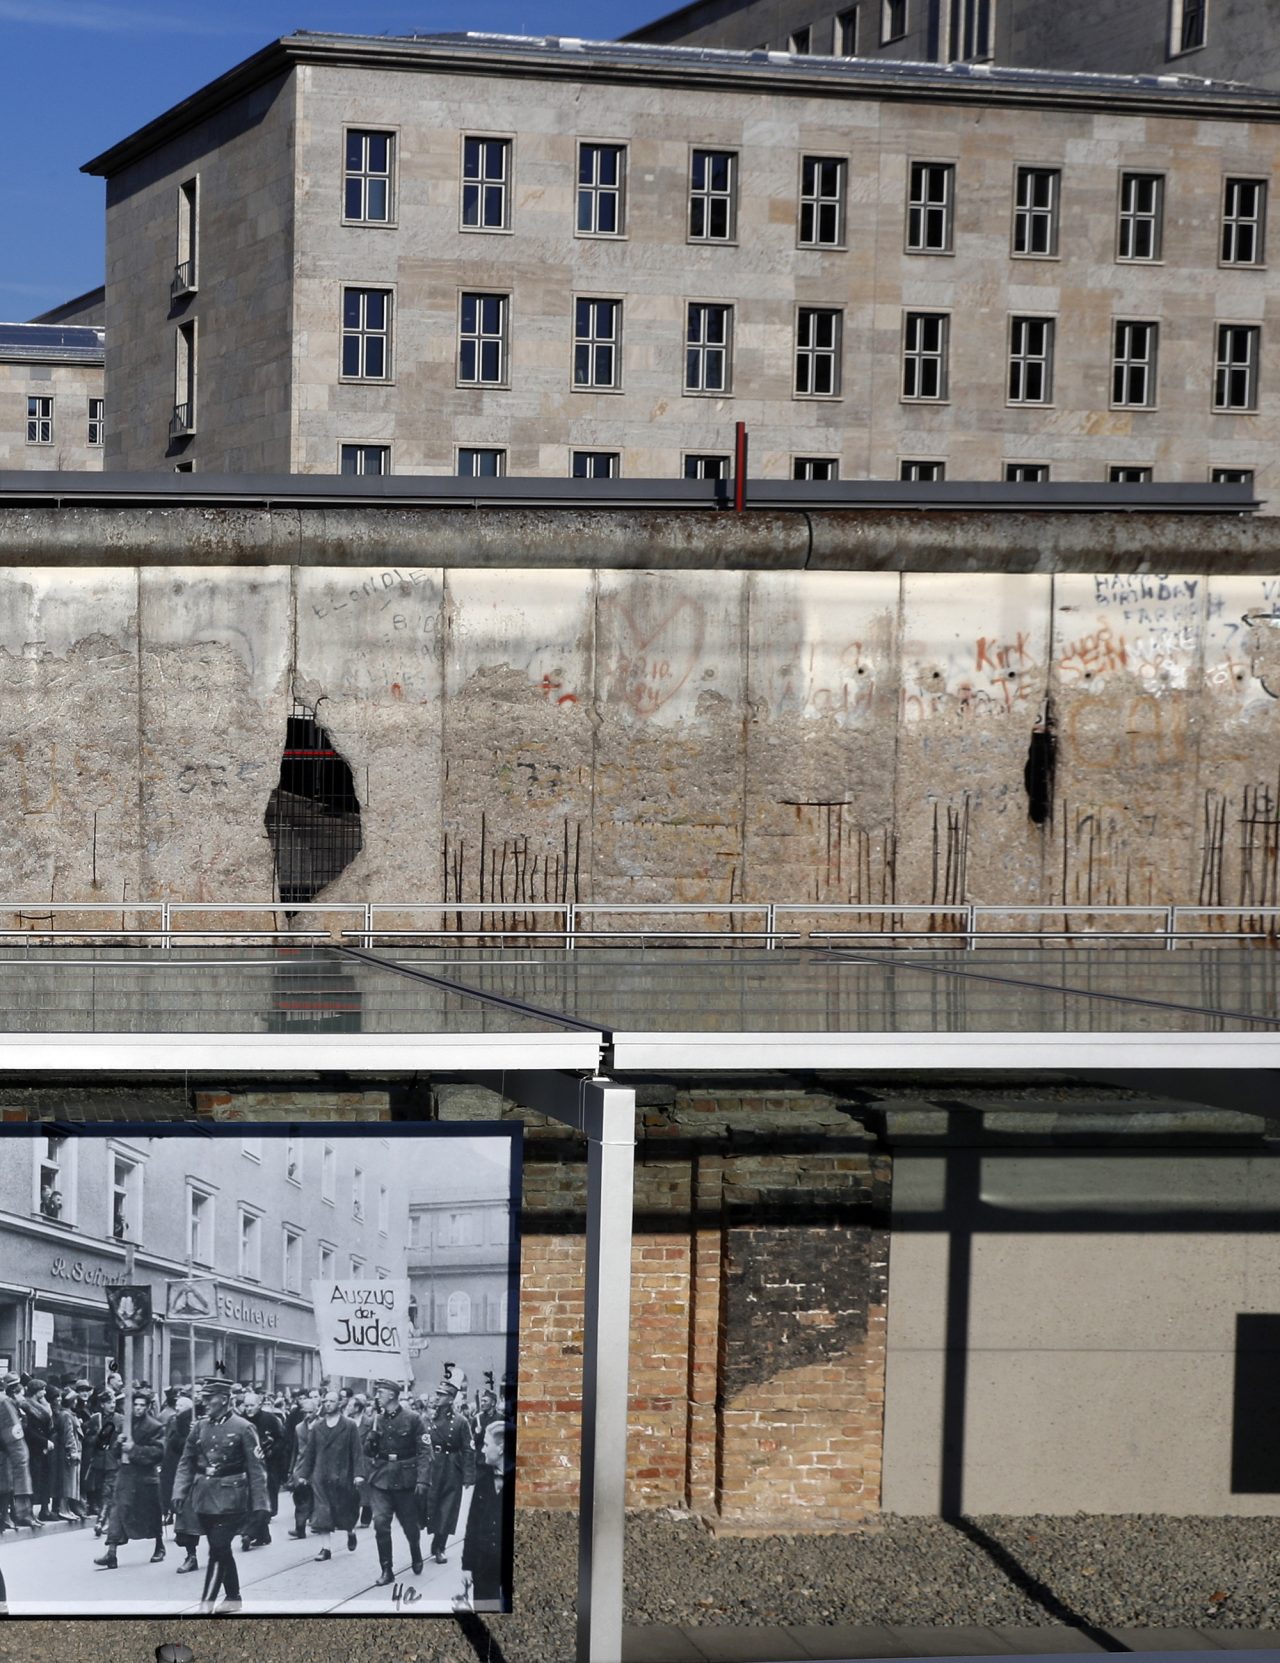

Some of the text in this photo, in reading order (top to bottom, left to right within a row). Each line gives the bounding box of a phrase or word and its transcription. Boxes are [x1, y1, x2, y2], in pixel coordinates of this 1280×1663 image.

[330, 1285, 395, 1311] Auszug
[224, 1296, 279, 1329] Schreyer
[354, 1306, 376, 1319] der
[333, 1318, 401, 1348] Juden
